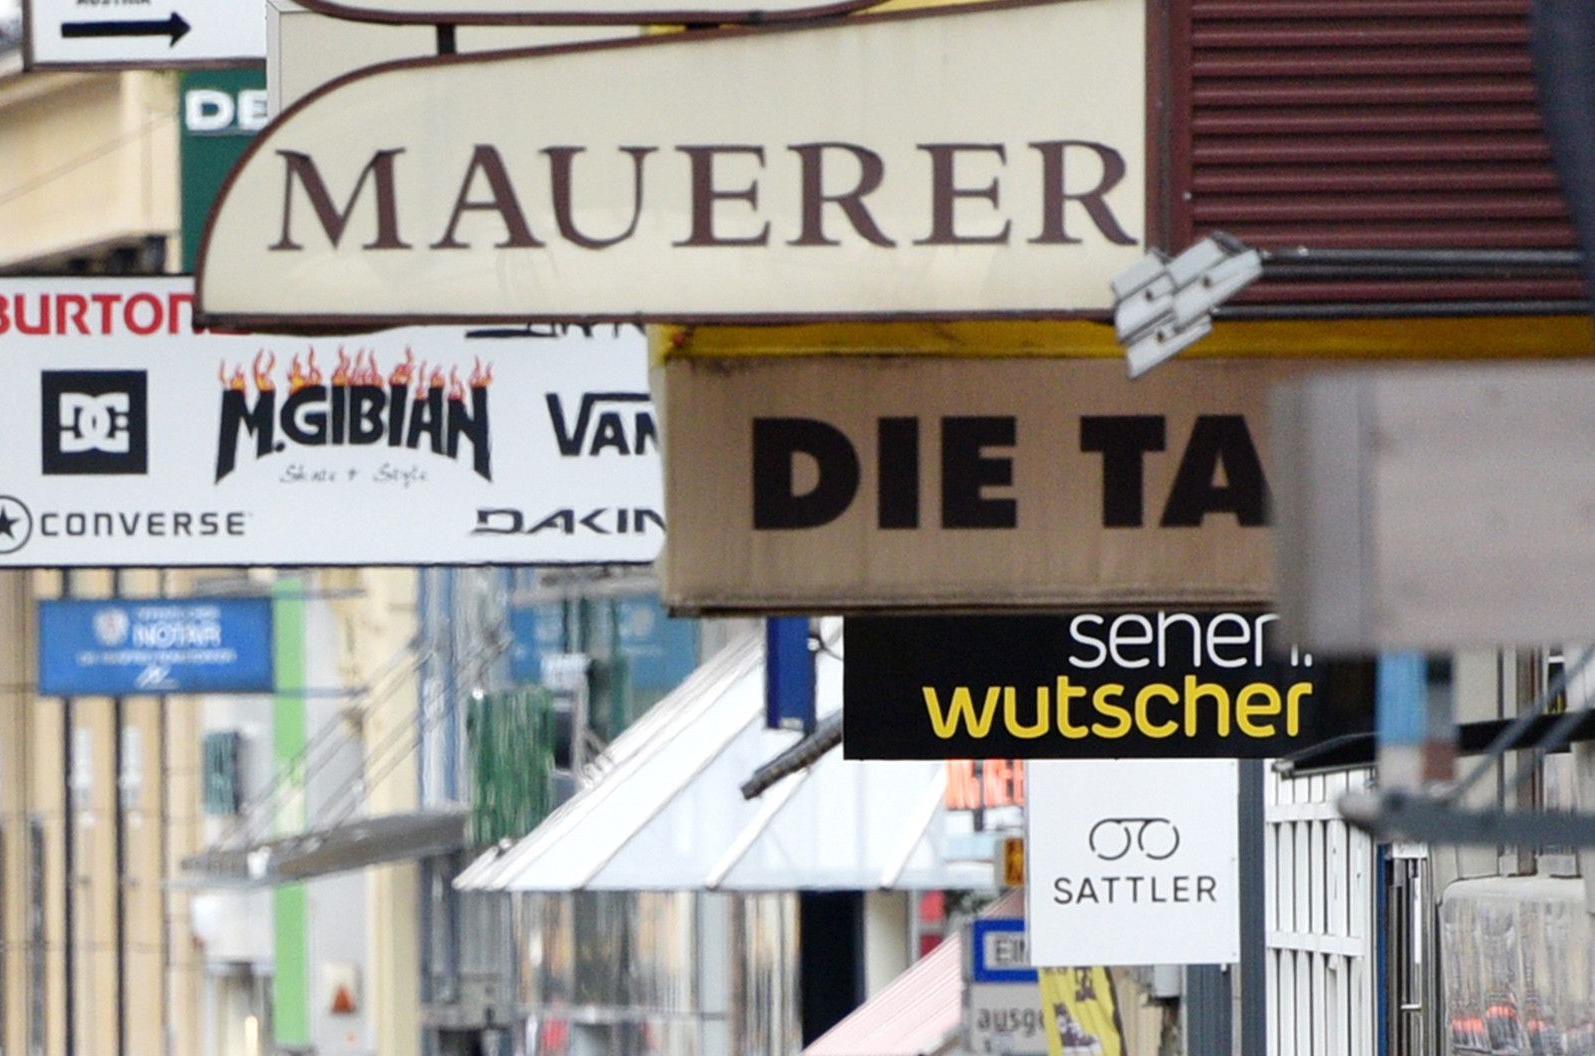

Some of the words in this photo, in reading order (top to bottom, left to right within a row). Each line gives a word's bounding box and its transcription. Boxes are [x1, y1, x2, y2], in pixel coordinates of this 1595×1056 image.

[267, 141, 1140, 251] MAUERER
[752, 416, 1017, 530] DIE
[1080, 415, 1274, 528] TA
[41, 512, 248, 537] CONVERSE
[922, 674, 1313, 739] wutscher
[1053, 876, 1217, 904] SATTLER
